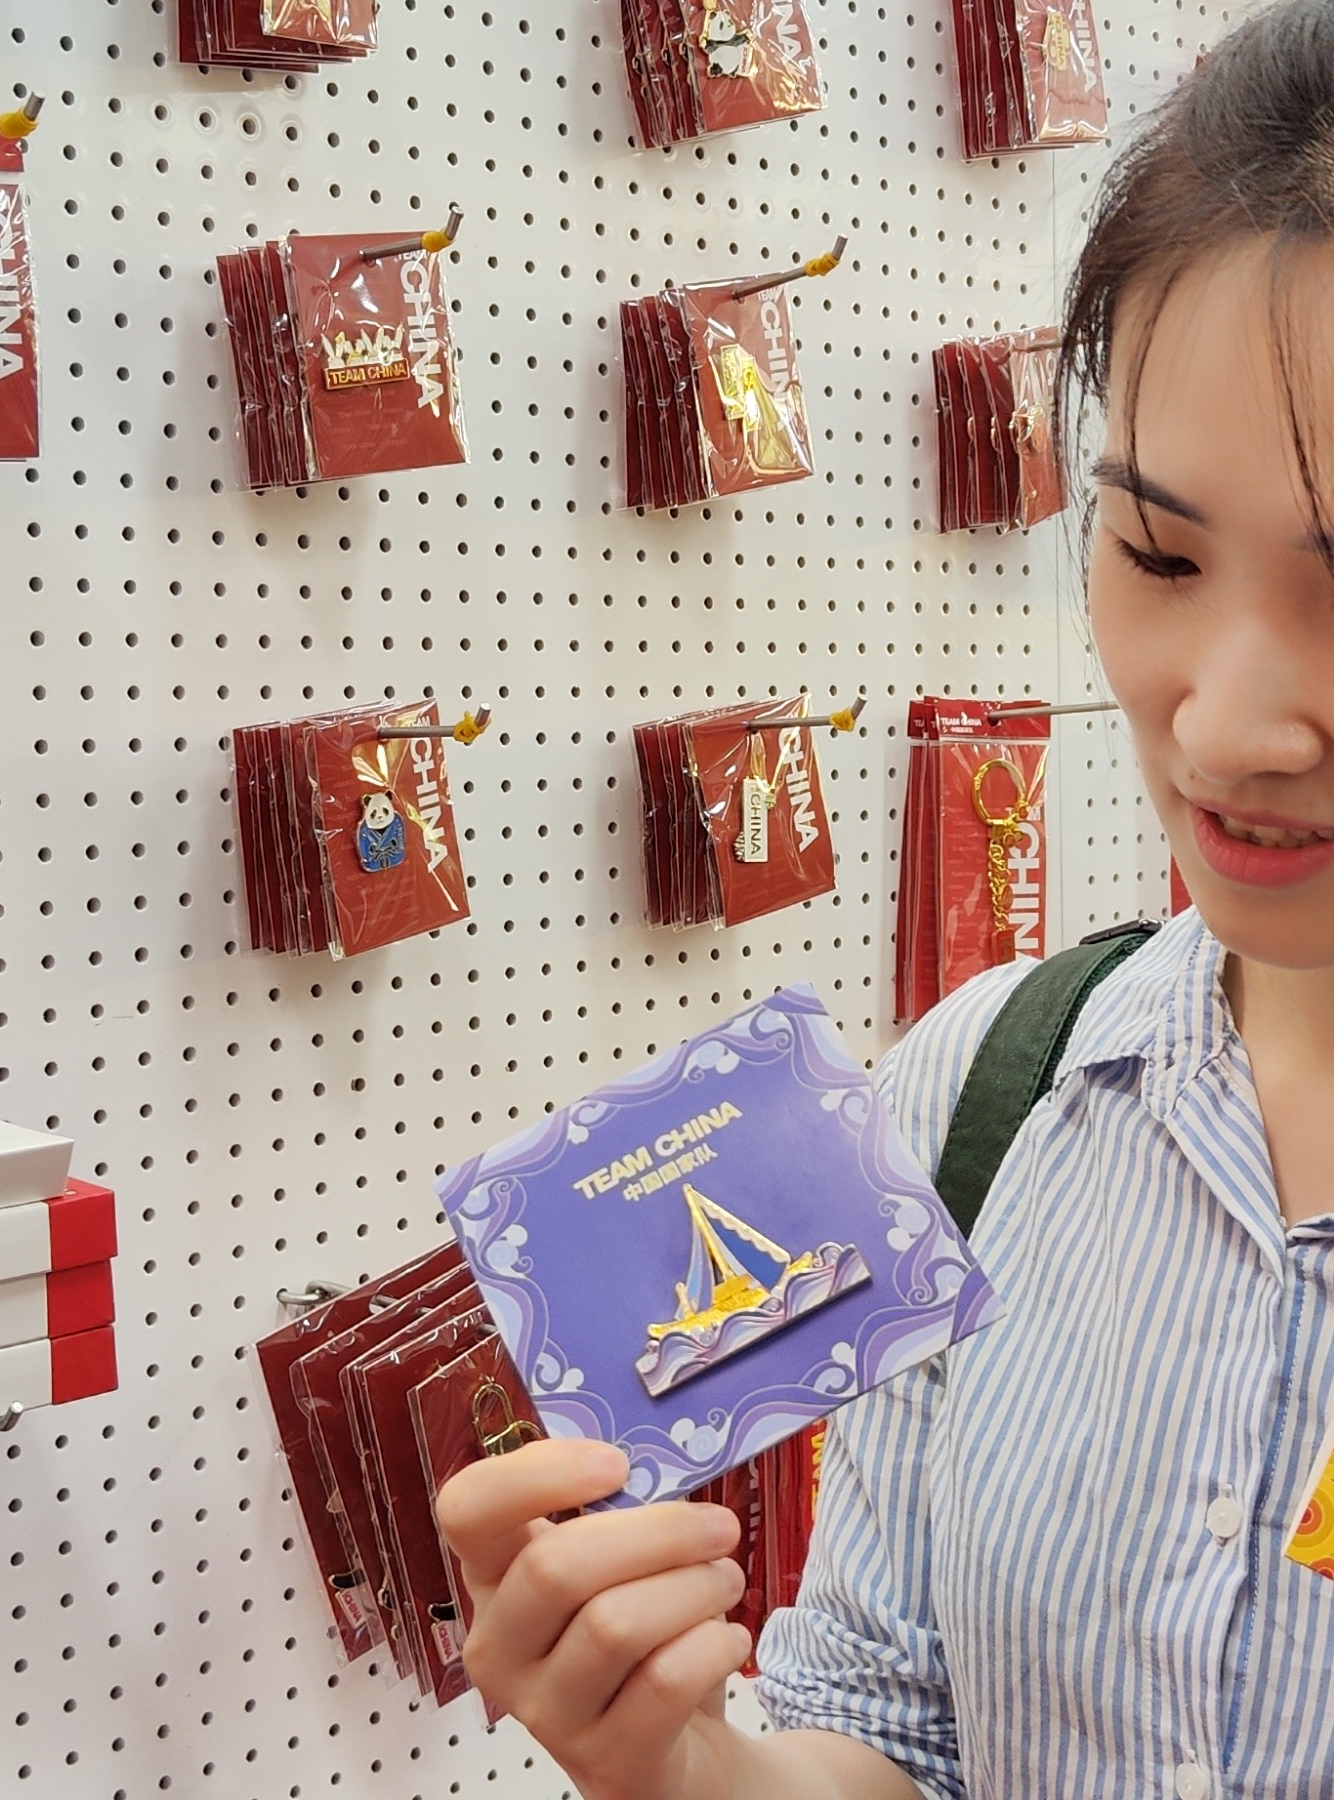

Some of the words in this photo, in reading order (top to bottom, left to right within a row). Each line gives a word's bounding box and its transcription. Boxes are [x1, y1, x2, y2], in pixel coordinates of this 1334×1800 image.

[1073, 0, 1097, 93] HINA
[330, 368, 366, 385] TEAM
[368, 363, 407, 380] CHINA
[400, 260, 444, 409] CHINA
[410, 738, 448, 873] CHINA
[750, 793, 762, 855] CHINA
[778, 727, 819, 852] CHINA
[1007, 822, 1040, 960] CHIN
[572, 1145, 654, 1200] TEAM
[654, 1101, 743, 1158] CHINA
[622, 1142, 718, 1201] 中国国家队
[342, 1592, 362, 1622] CHINA
[438, 1626, 453, 1659] CHINA
